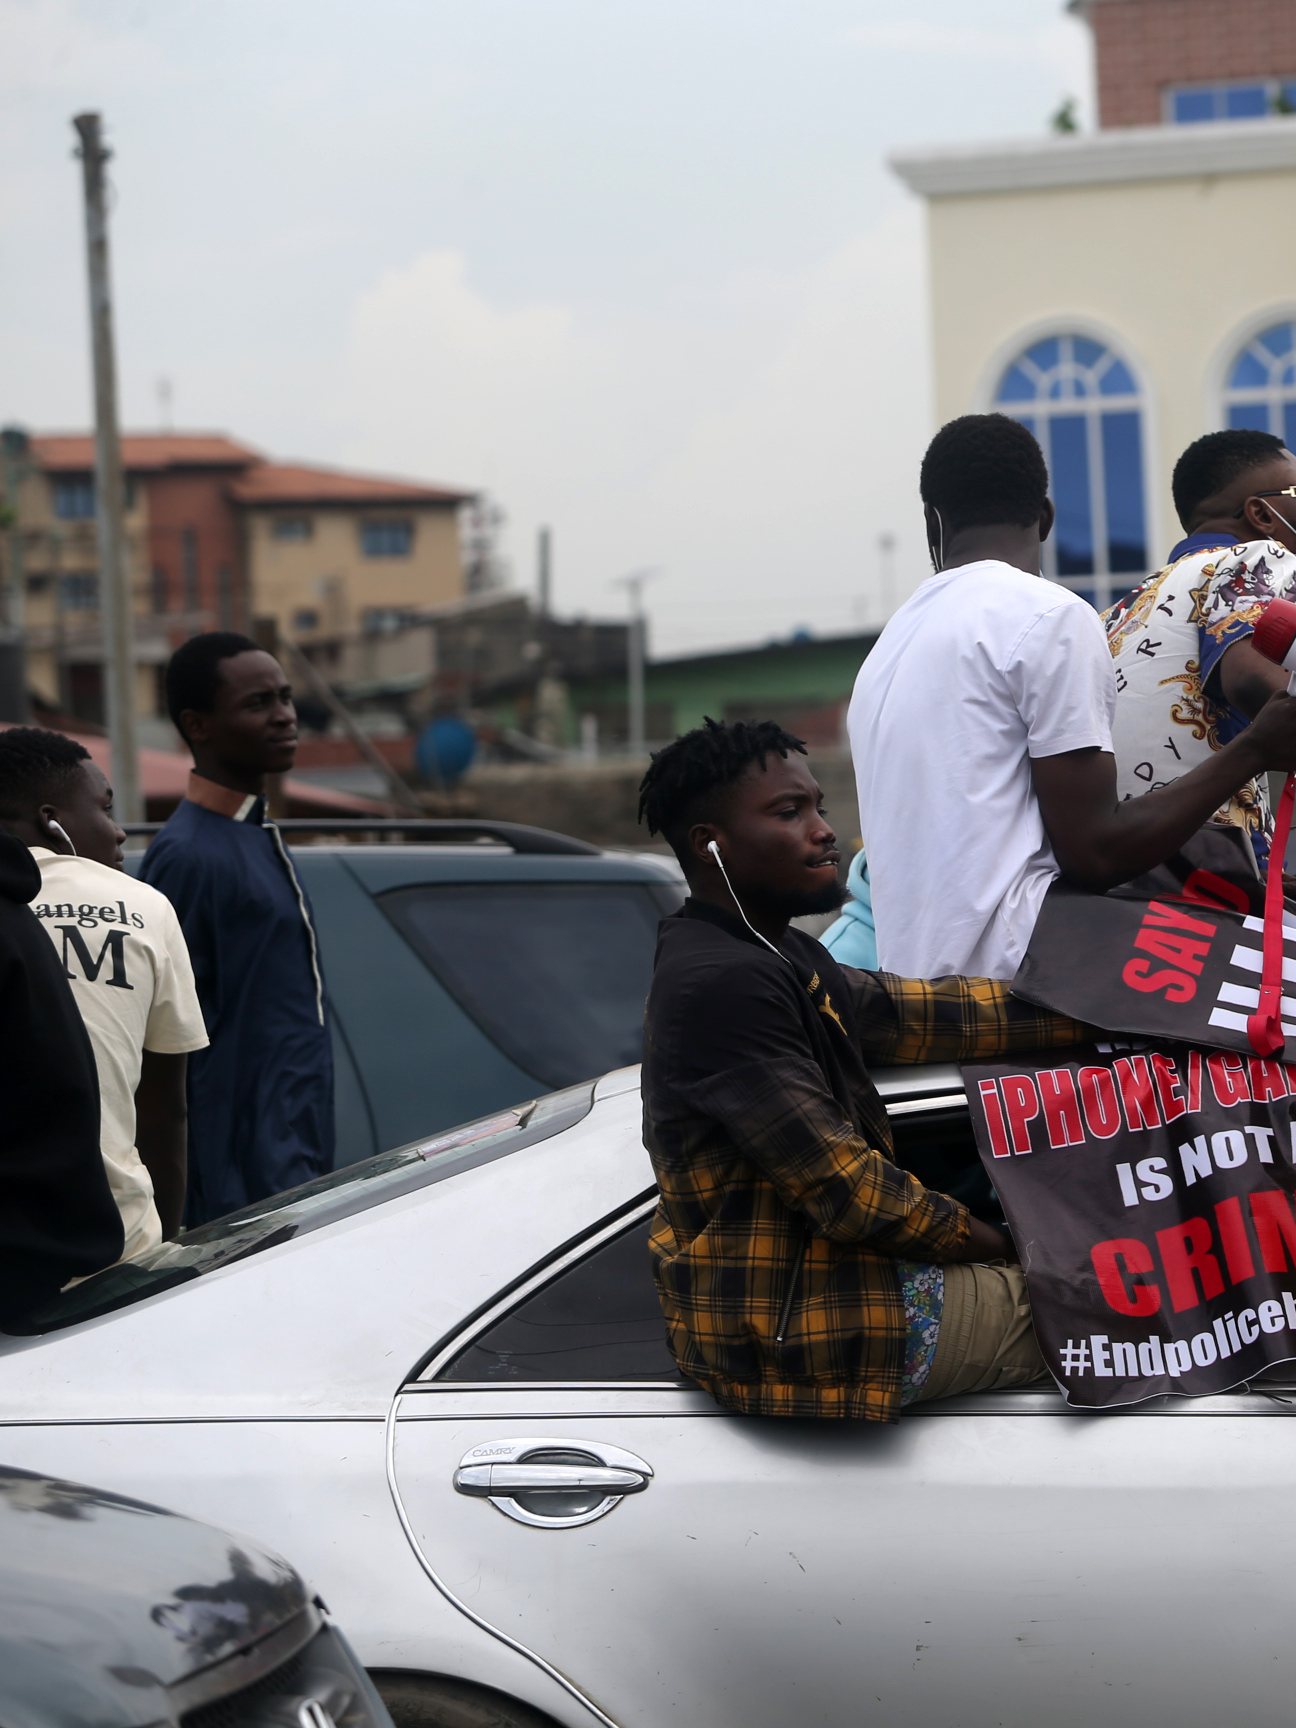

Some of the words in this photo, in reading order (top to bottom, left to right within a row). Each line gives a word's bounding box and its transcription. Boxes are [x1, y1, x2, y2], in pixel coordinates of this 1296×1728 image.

[1122, 900, 1218, 1003] SAY
[1115, 1156, 1174, 1207] IS
[1178, 1125, 1275, 1187] NOT
[472, 1446, 516, 1458] CAMRY
